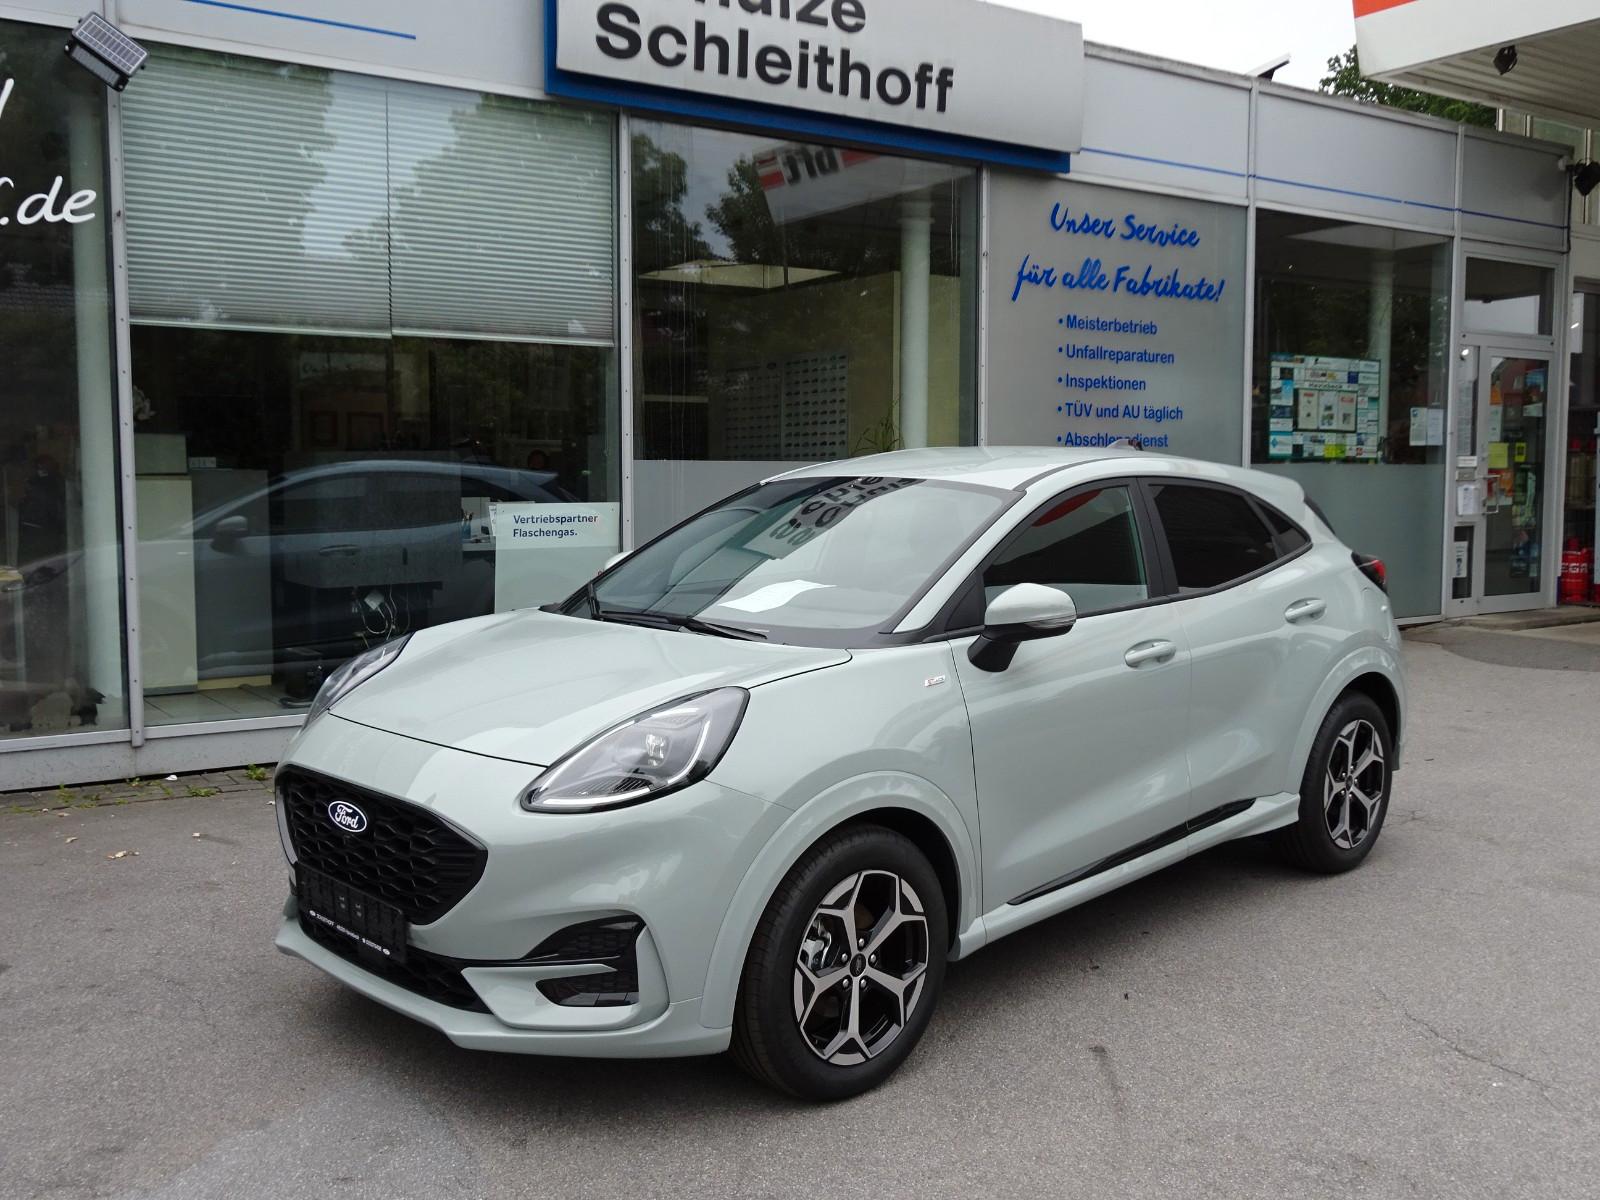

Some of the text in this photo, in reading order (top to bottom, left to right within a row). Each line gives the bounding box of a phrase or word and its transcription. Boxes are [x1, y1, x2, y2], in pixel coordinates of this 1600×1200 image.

[595, 2, 954, 113] Schleithoff
[1050, 202, 1200, 248] Unser Service
[1011, 254, 1225, 302] für alle Fabrikate!
[1066, 314, 1158, 335] Meisterbetrieb
[1066, 343, 1175, 364] Unfallreparaturen
[1065, 373, 1147, 392] Inspektionen
[1065, 400, 1183, 423] TÜV und AU täglich
[513, 513, 599, 525] Vertriebspartner
[513, 527, 578, 538] Flaschengas.
[333, 803, 361, 830] Ford
